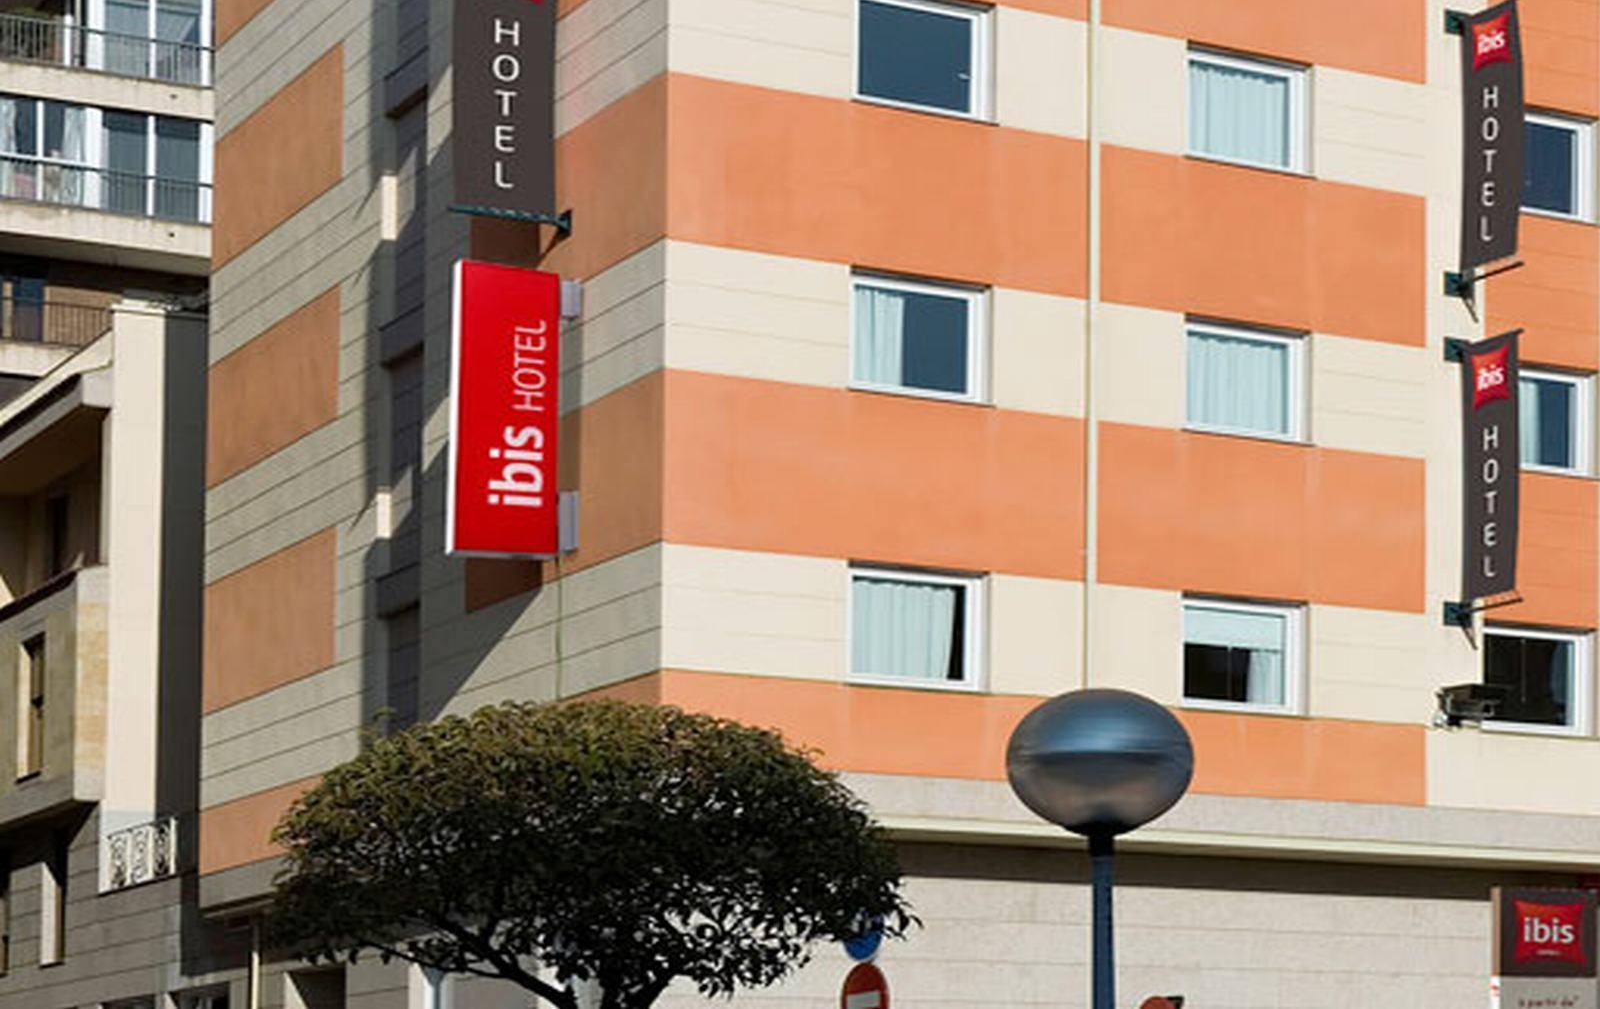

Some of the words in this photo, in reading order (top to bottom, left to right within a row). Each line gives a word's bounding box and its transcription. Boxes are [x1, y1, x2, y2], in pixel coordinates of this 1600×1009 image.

[1476, 29, 1505, 55] ibis
[493, 19, 520, 188] HOTEL
[1481, 86, 1499, 241] HOTEL
[512, 319, 548, 412] HOTEL
[1476, 364, 1504, 391] ibis
[487, 425, 545, 507] ibis
[1483, 425, 1499, 577] HOTEL
[1523, 917, 1575, 944] ibis
